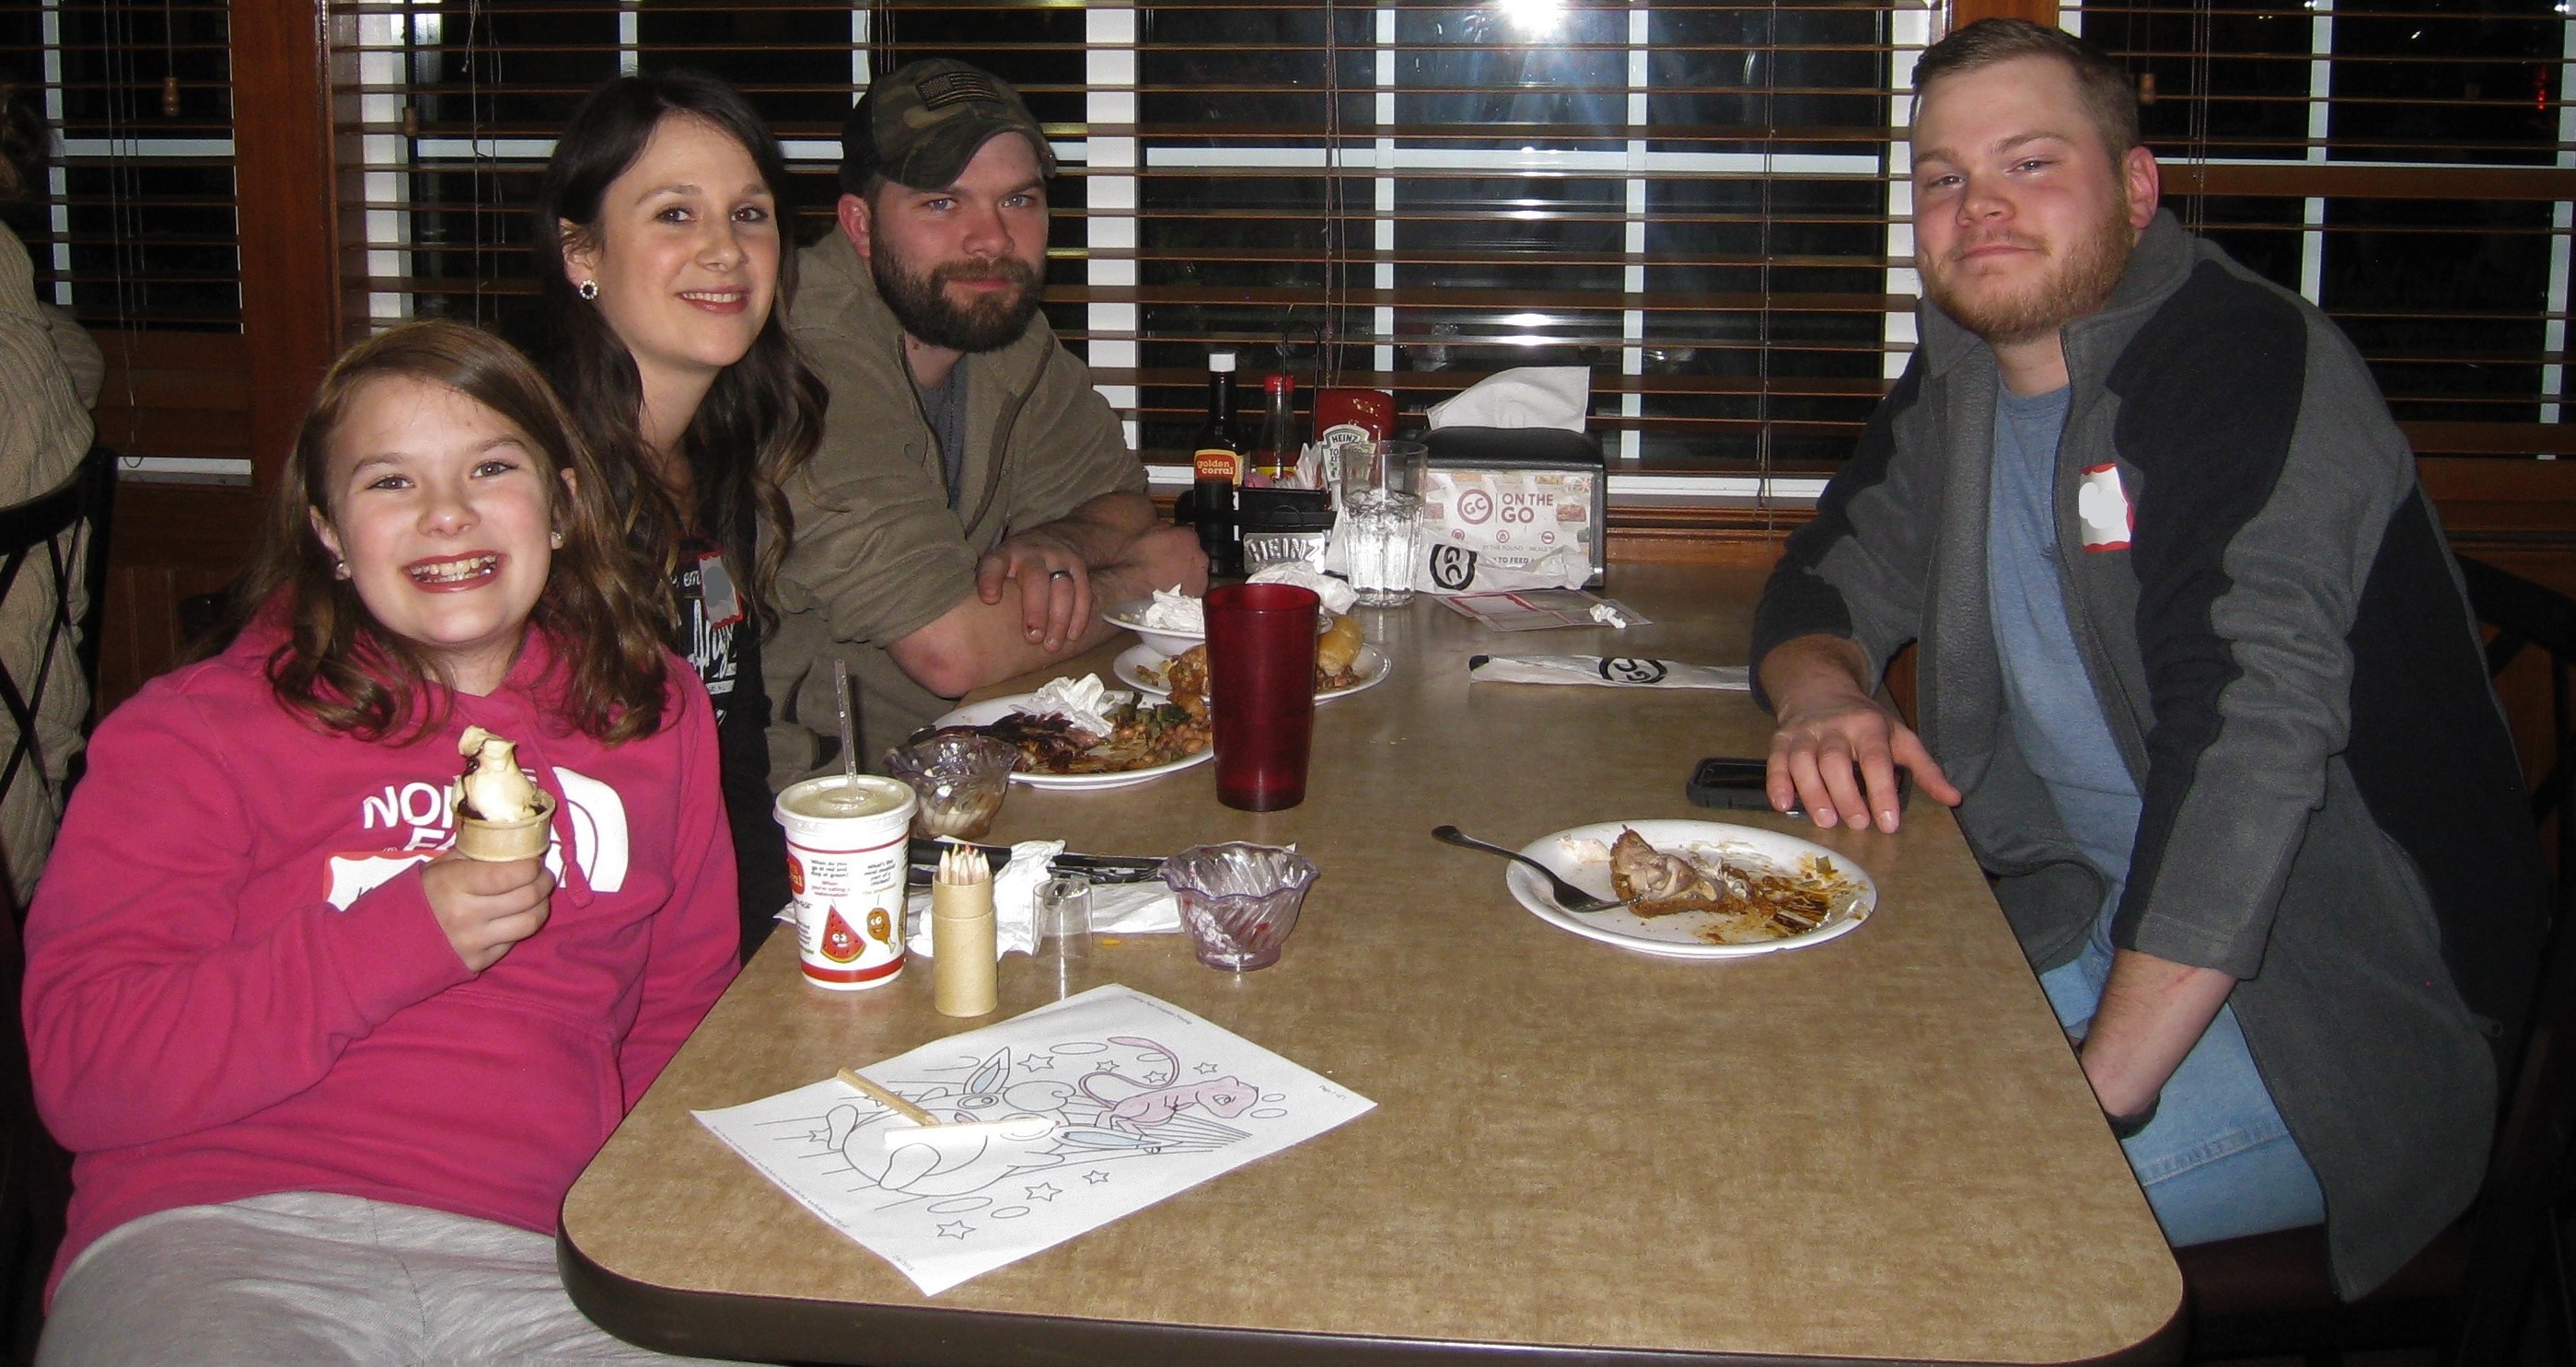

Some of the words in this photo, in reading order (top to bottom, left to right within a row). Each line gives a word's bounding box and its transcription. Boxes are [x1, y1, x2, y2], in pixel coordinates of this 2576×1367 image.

[1330, 434, 1358, 443] HEINZ
[1197, 459, 1230, 469] golden
[1201, 467, 1234, 475] corral
[1502, 492, 1525, 505] ON
[1527, 493, 1554, 506] THE
[1464, 497, 1488, 516] GC
[1501, 507, 1535, 524] GO
[1249, 538, 1320, 562] HEINZ
